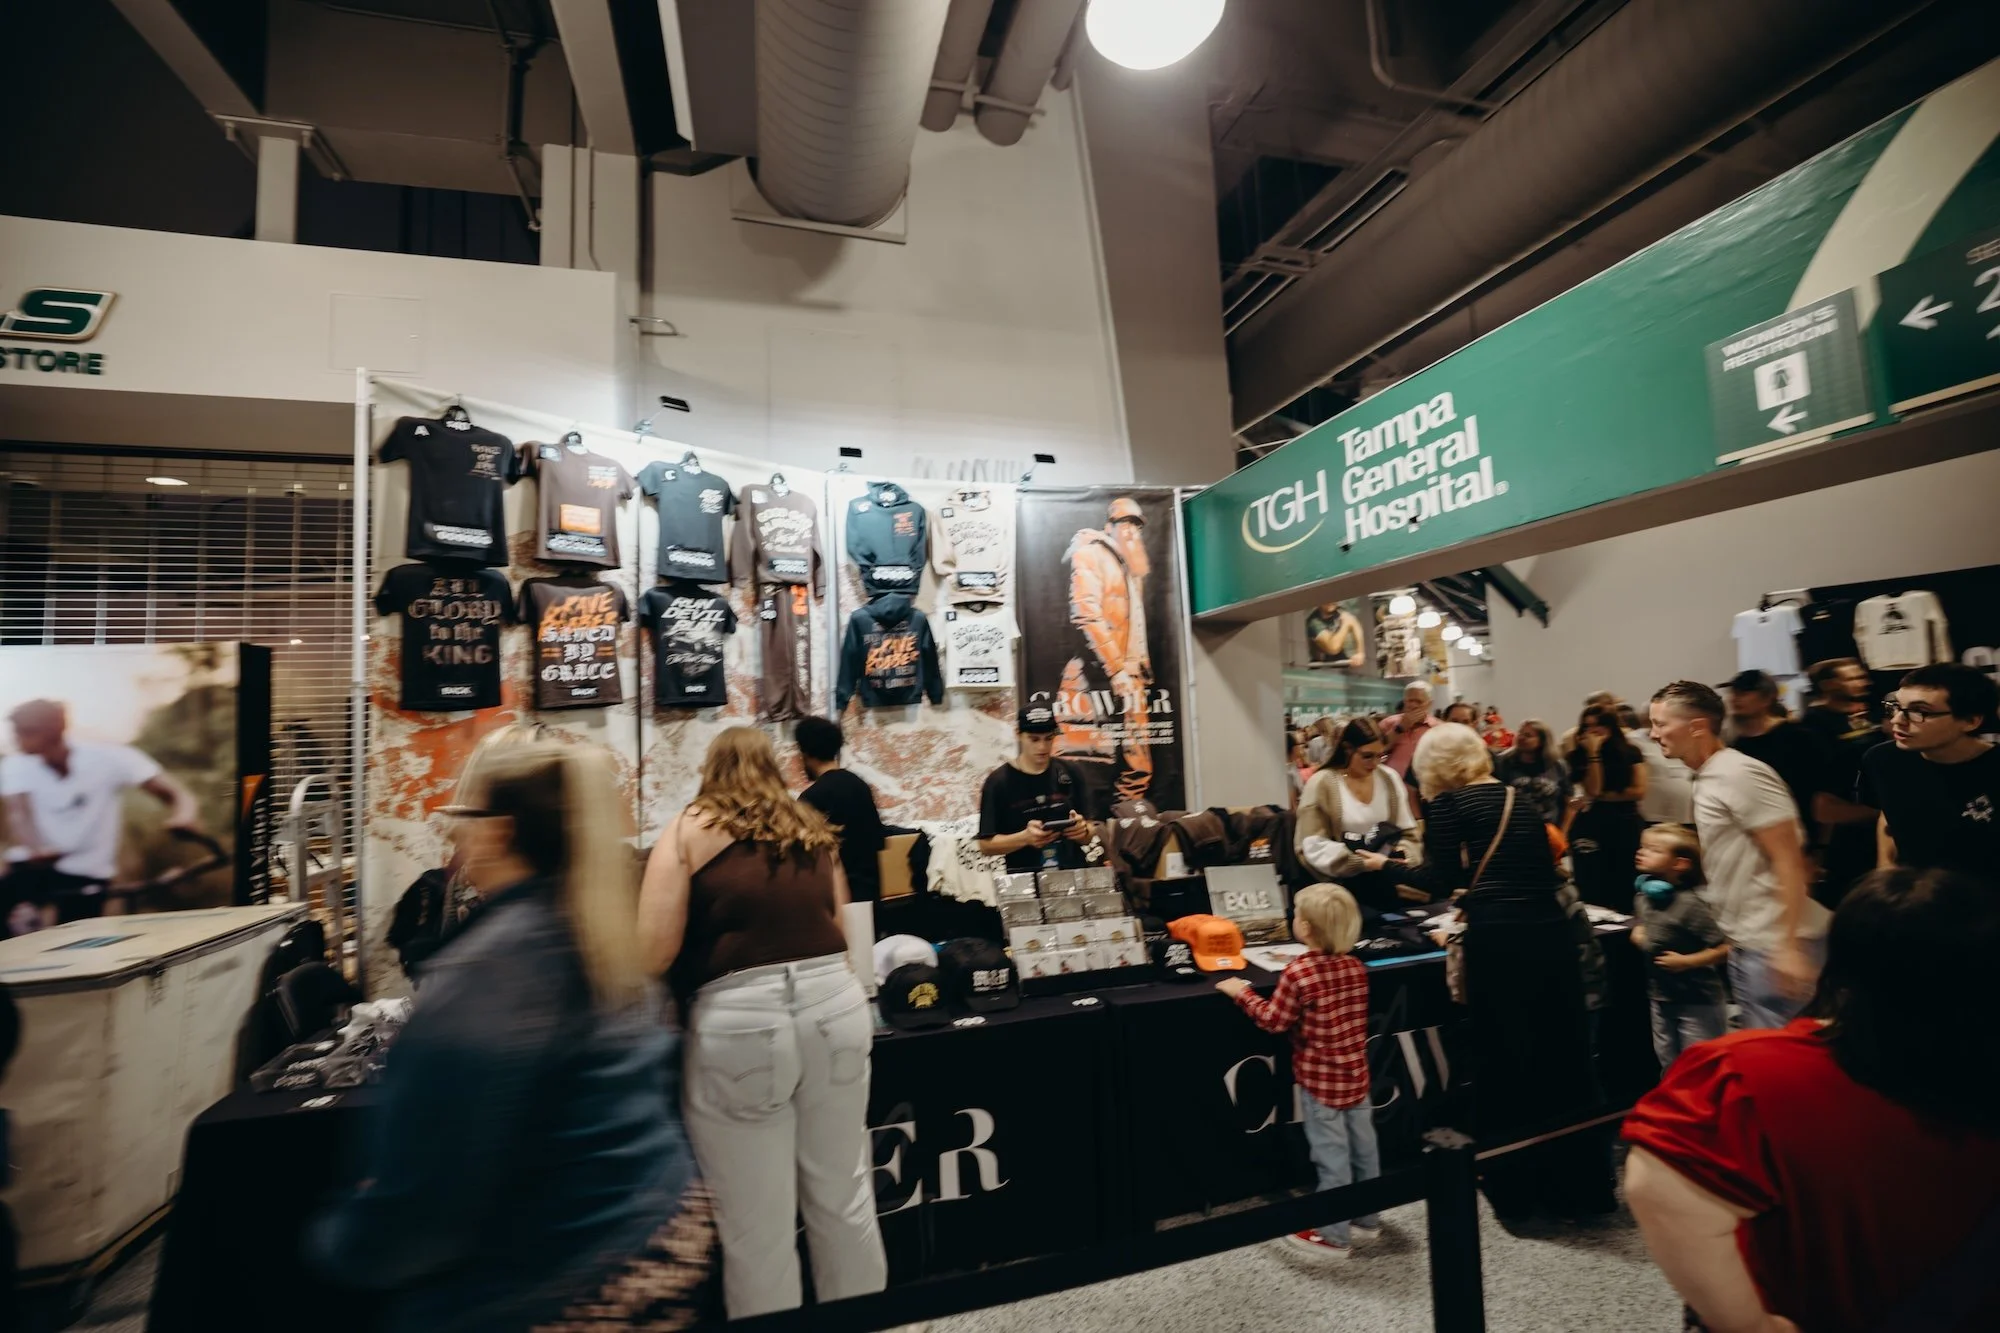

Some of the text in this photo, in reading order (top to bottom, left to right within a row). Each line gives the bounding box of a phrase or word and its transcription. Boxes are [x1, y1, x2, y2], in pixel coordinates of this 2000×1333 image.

[1337, 391, 1457, 467] Tampa
[1342, 415, 1480, 505] General
[1250, 469, 1328, 538] TGH
[670, 596, 716, 610] RUN
[661, 607, 726, 622] DEVIL
[422, 644, 494, 666] KING
[541, 662, 617, 682] GRACE
